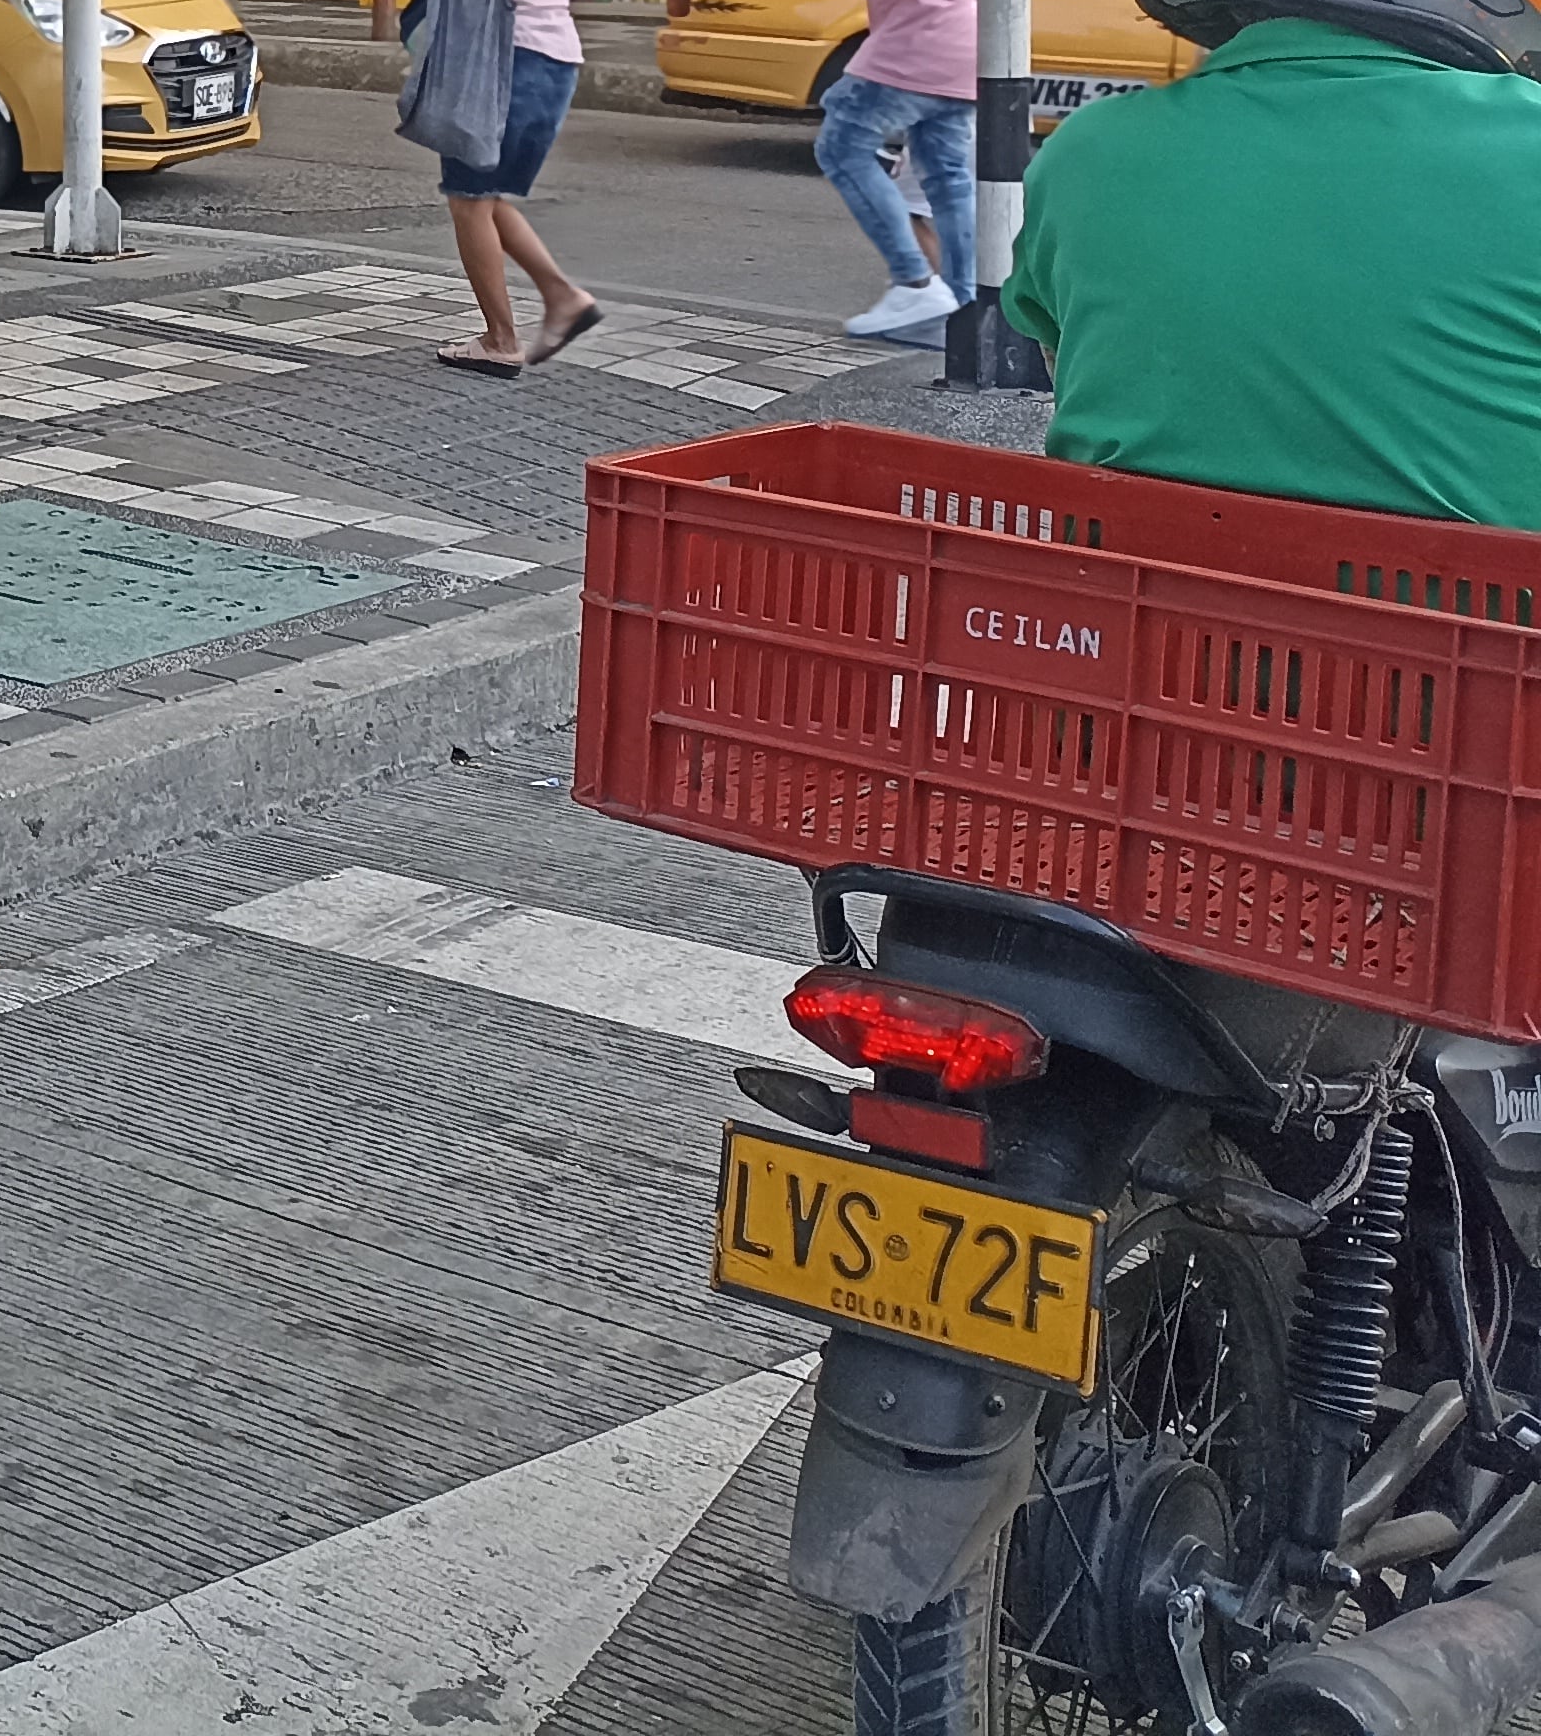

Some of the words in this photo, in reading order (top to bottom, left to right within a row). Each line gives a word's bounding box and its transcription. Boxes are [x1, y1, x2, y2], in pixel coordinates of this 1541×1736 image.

[962, 603, 1104, 663] CEILAN
[731, 1158, 876, 1281] LVS
[916, 1205, 1082, 1335] 72F
[829, 1285, 954, 1340] COLOMBIA
